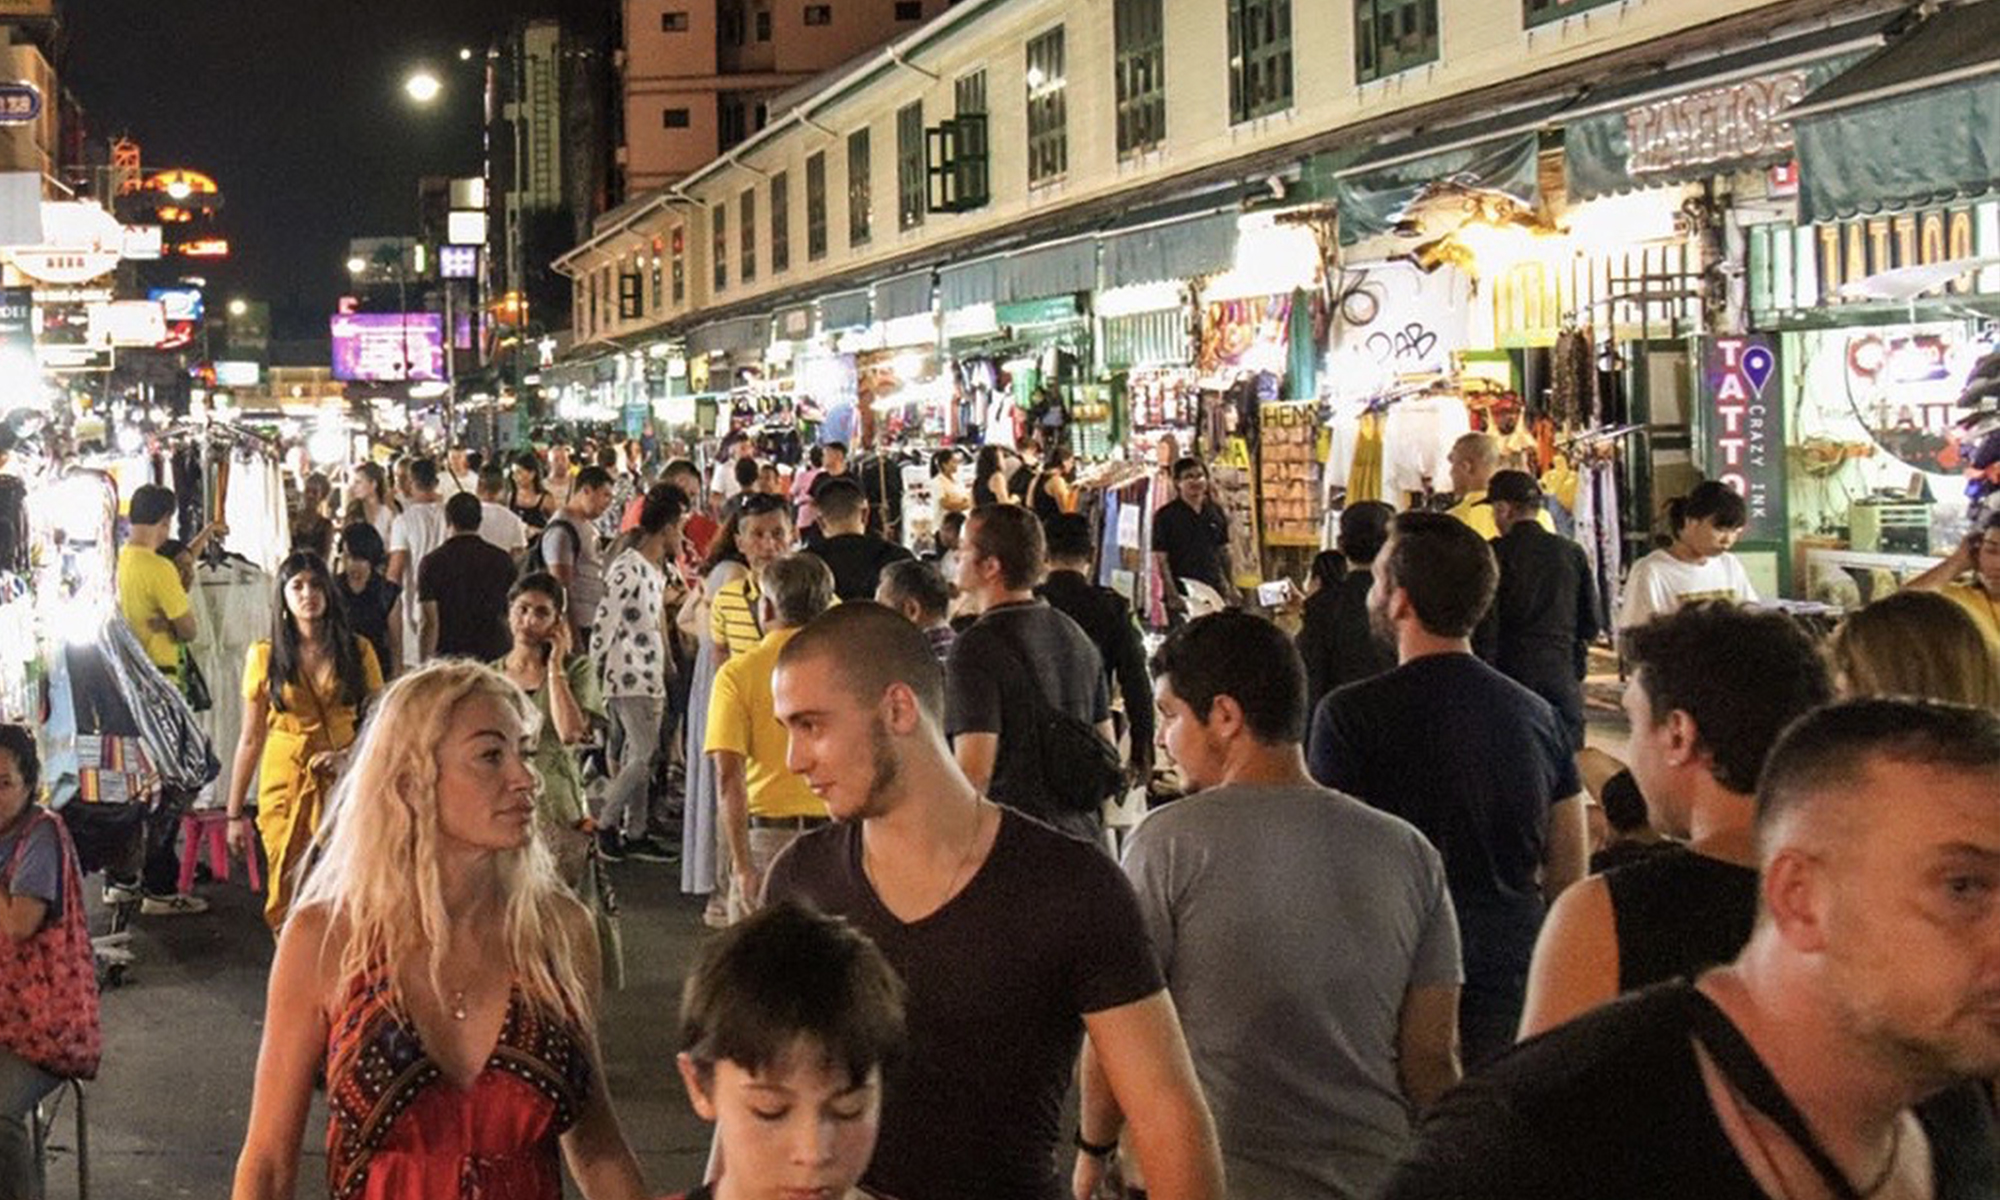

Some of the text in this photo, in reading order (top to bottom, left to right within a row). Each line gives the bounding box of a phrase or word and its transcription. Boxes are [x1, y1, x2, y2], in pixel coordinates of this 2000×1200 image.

[1820, 210, 1972, 306] TATTOO
[1263, 403, 1320, 428] HENN
[1717, 340, 1746, 498] TATTO
[1749, 404, 1767, 518] CRAZY INK
[1869, 399, 1956, 433] TATT
